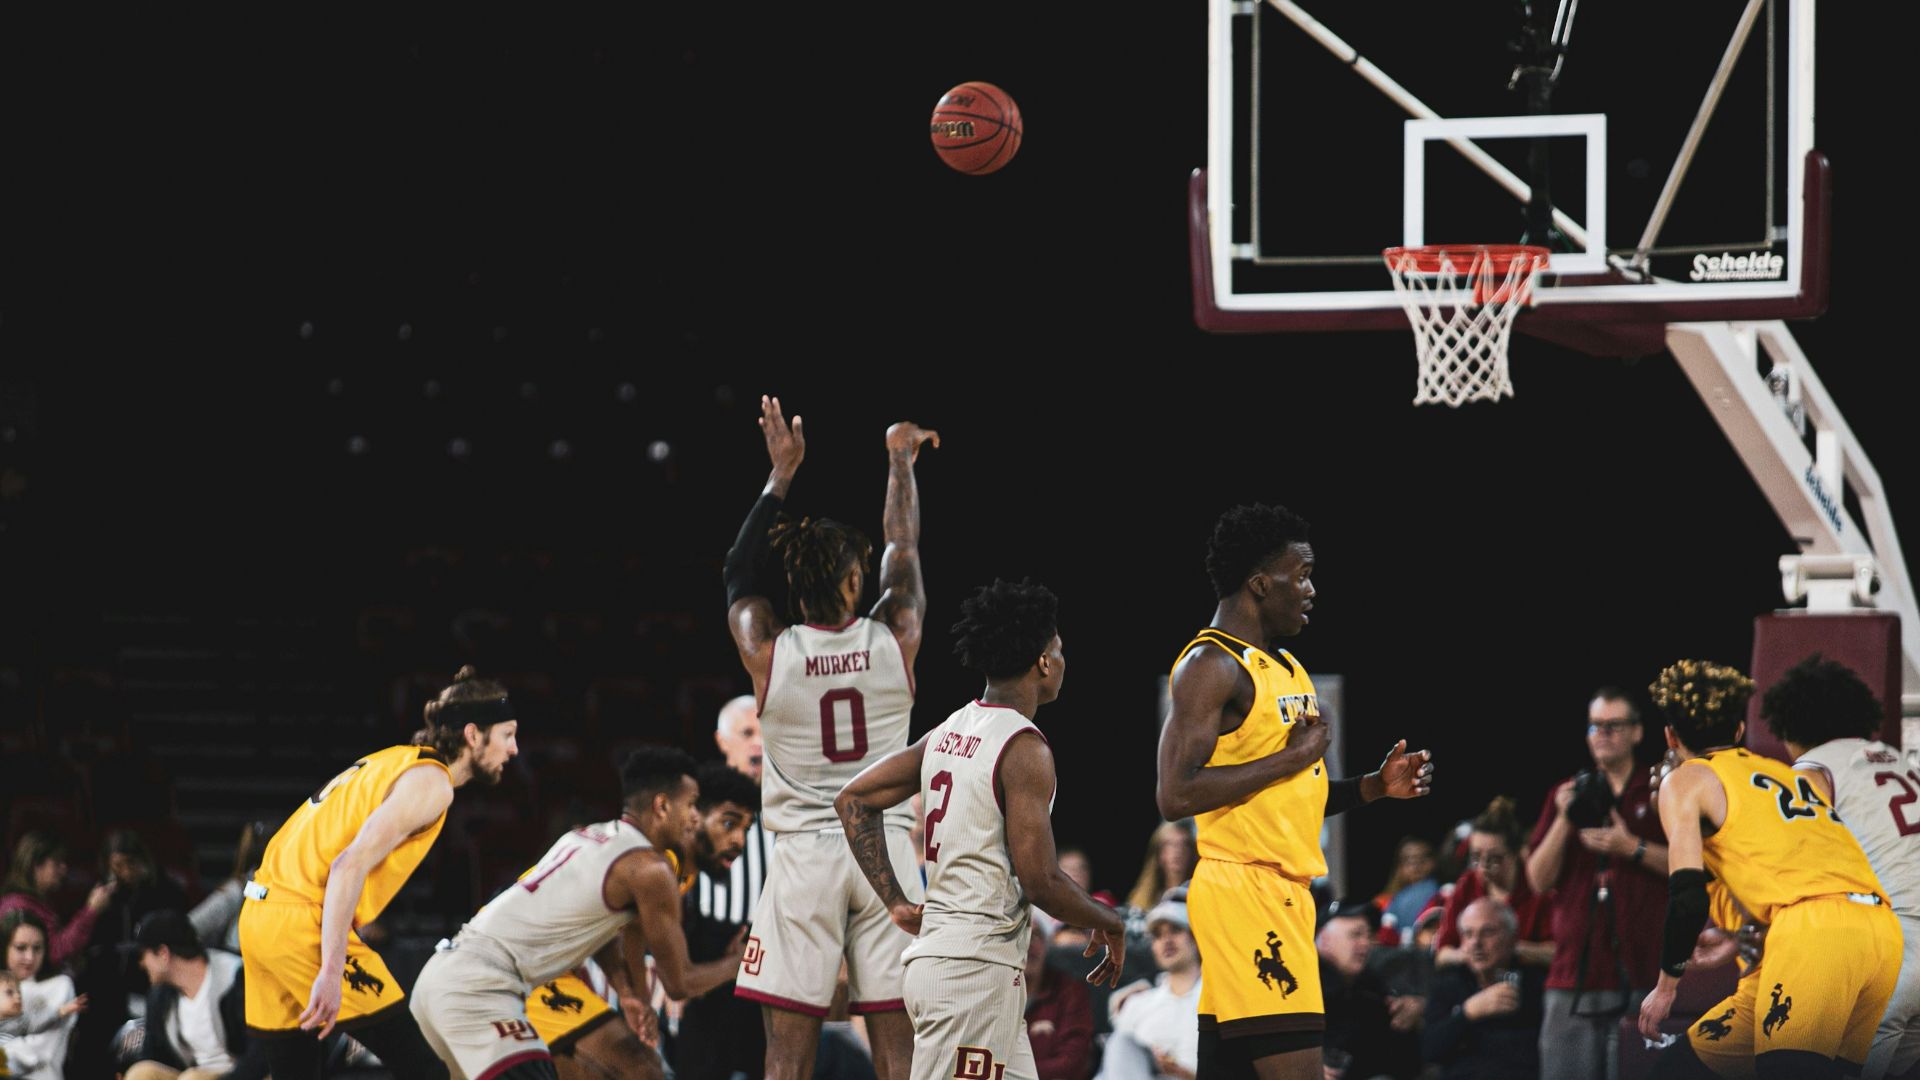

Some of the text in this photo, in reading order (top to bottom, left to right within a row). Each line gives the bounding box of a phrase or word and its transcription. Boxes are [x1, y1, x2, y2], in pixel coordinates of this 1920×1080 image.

[1689, 251, 1784, 281] Schelde
[805, 650, 871, 676] MURKEY
[819, 686, 869, 764] 0
[925, 769, 953, 863] 2
[1874, 770, 1920, 836] 2
[740, 935, 766, 976] DU
[491, 1018, 539, 1041] DU
